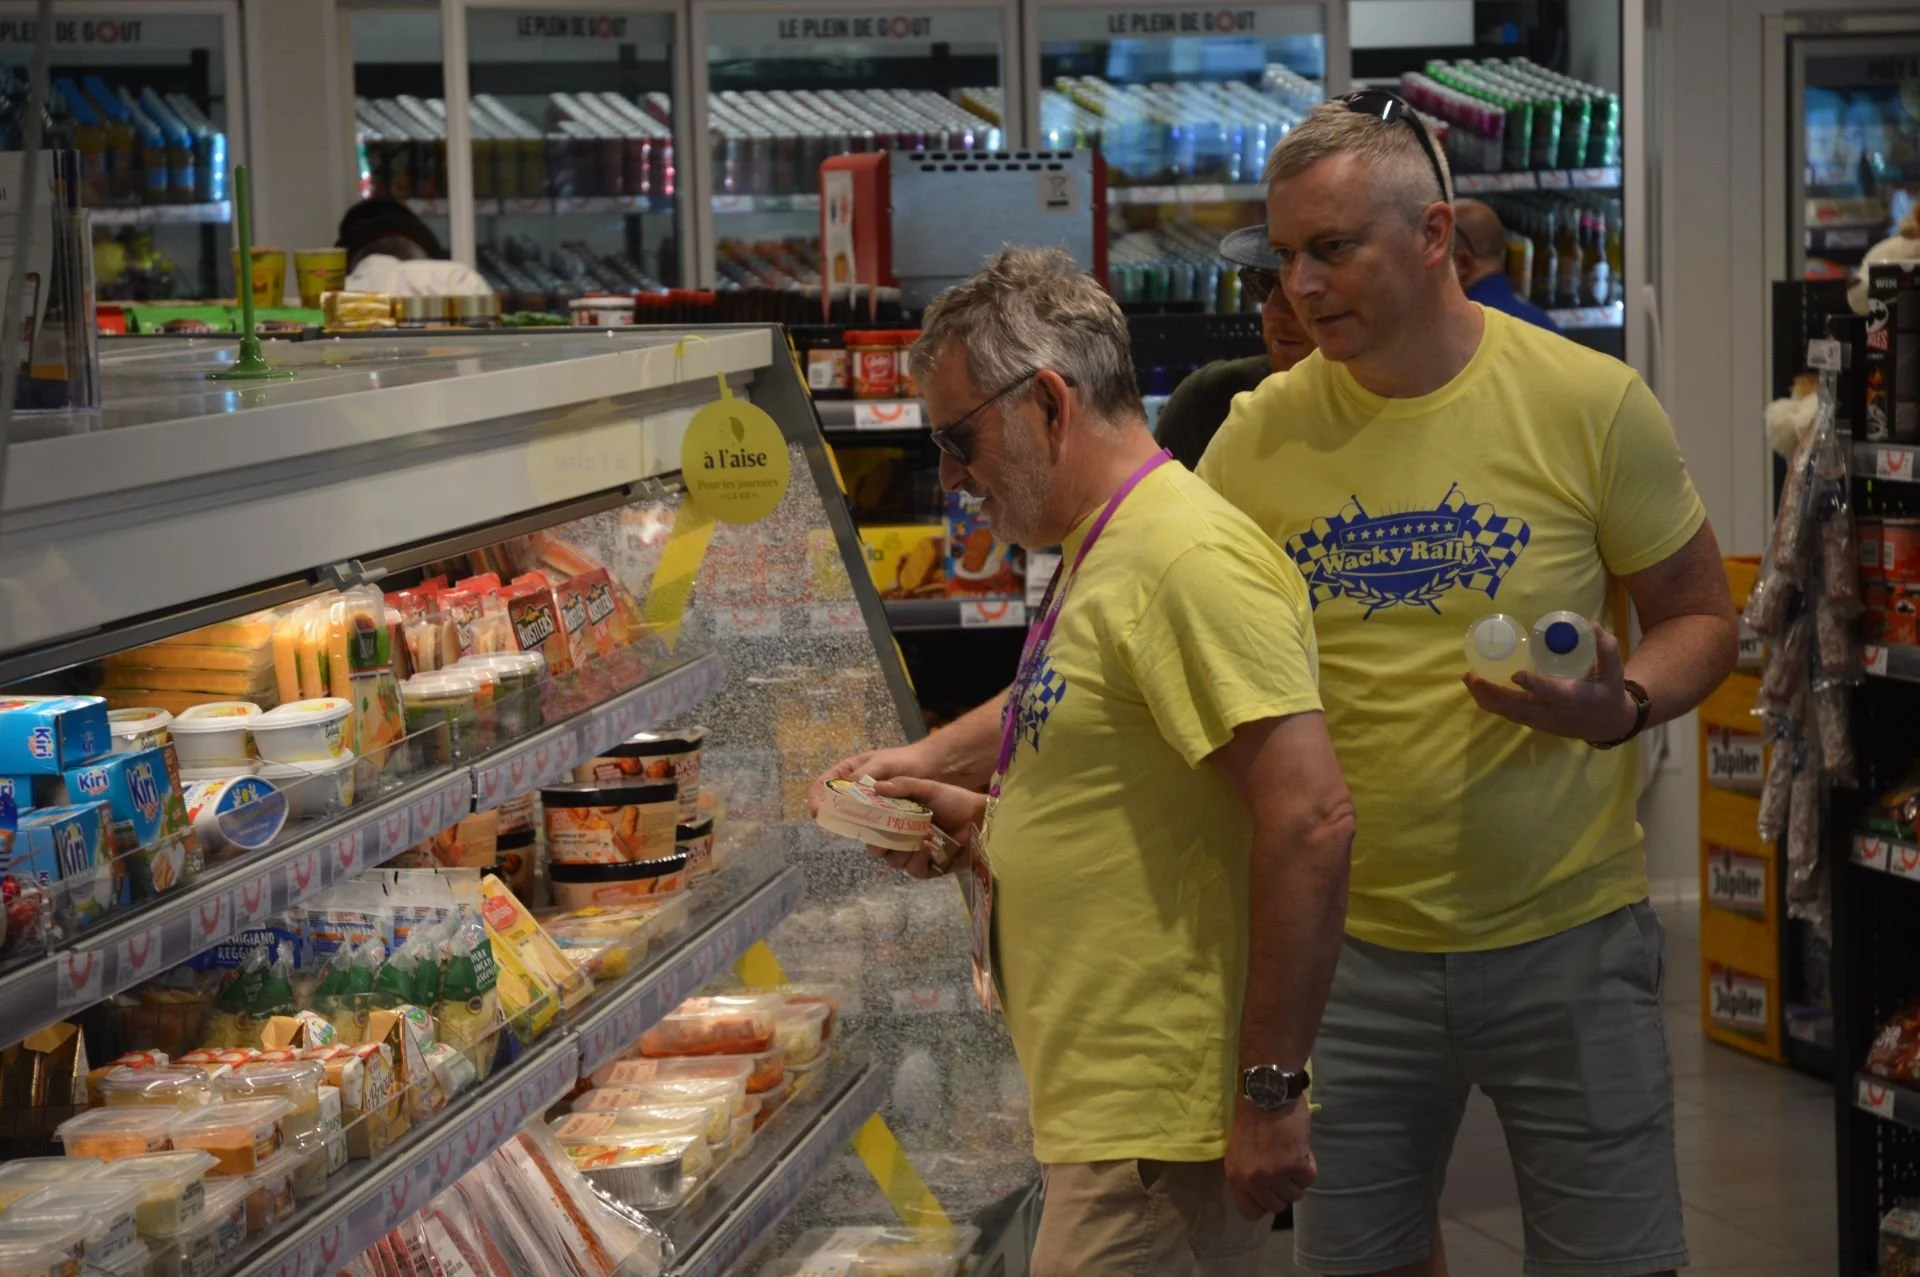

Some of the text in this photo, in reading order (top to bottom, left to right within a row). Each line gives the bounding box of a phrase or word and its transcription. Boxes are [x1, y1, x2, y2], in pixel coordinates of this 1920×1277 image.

[56, 21, 77, 42] DE
[518, 15, 531, 36] LE
[571, 15, 586, 36] DE
[779, 18, 798, 38] LE
[802, 18, 849, 38] PLEIN
[854, 18, 873, 37] DE
[1108, 13, 1125, 33] LE
[1131, 13, 1176, 32] PLEIN
[1181, 12, 1198, 31] DE
[1875, 279, 1897, 289] WIN
[704, 448, 768, 469] à l'aise
[698, 480, 719, 490] Pour
[1320, 540, 1481, 575] Wacky Rally
[517, 607, 554, 649] RUSTLERS
[36, 728, 52, 758] Kiri
[1712, 747, 1759, 779] Jupiler
[80, 770, 108, 791] Kiri
[129, 767, 158, 811] Kiri
[58, 831, 88, 878] Kiri
[1713, 867, 1761, 899] Jupiler
[1715, 985, 1763, 1020] Jupiler
